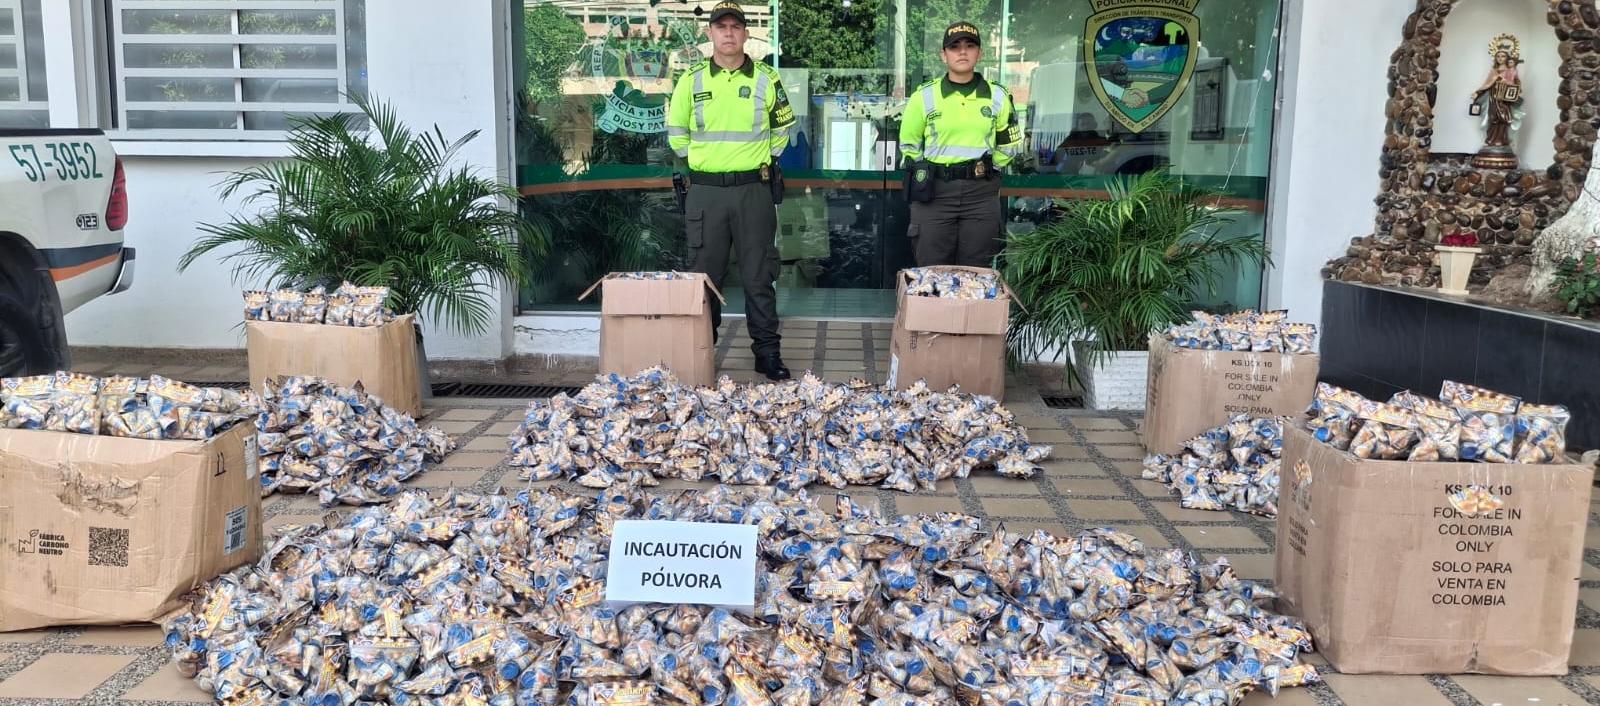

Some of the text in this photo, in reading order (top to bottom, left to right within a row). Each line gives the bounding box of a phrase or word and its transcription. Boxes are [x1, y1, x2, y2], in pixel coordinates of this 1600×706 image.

[8, 142, 103, 182] 57-3952
[1224, 372, 1243, 381] FOR
[1269, 375, 1279, 383] IN
[1250, 406, 1273, 415] PARA
[1445, 484, 1462, 495] KS
[1498, 485, 1512, 496] 10
[1433, 506, 1463, 519] FOR
[1507, 508, 1521, 520] IN
[1437, 523, 1513, 537] COLOMBIA
[39, 540, 70, 549] CARBONO
[624, 540, 742, 560] INCAUTACIÓN
[1455, 540, 1494, 553] ONLY
[39, 548, 63, 556] NEUTRO
[1431, 561, 1513, 574] SOLO PARA
[641, 566, 722, 590] PÓLVORA
[1437, 577, 1506, 590] VENTA EN
[1431, 593, 1506, 607] COLOMBIA
